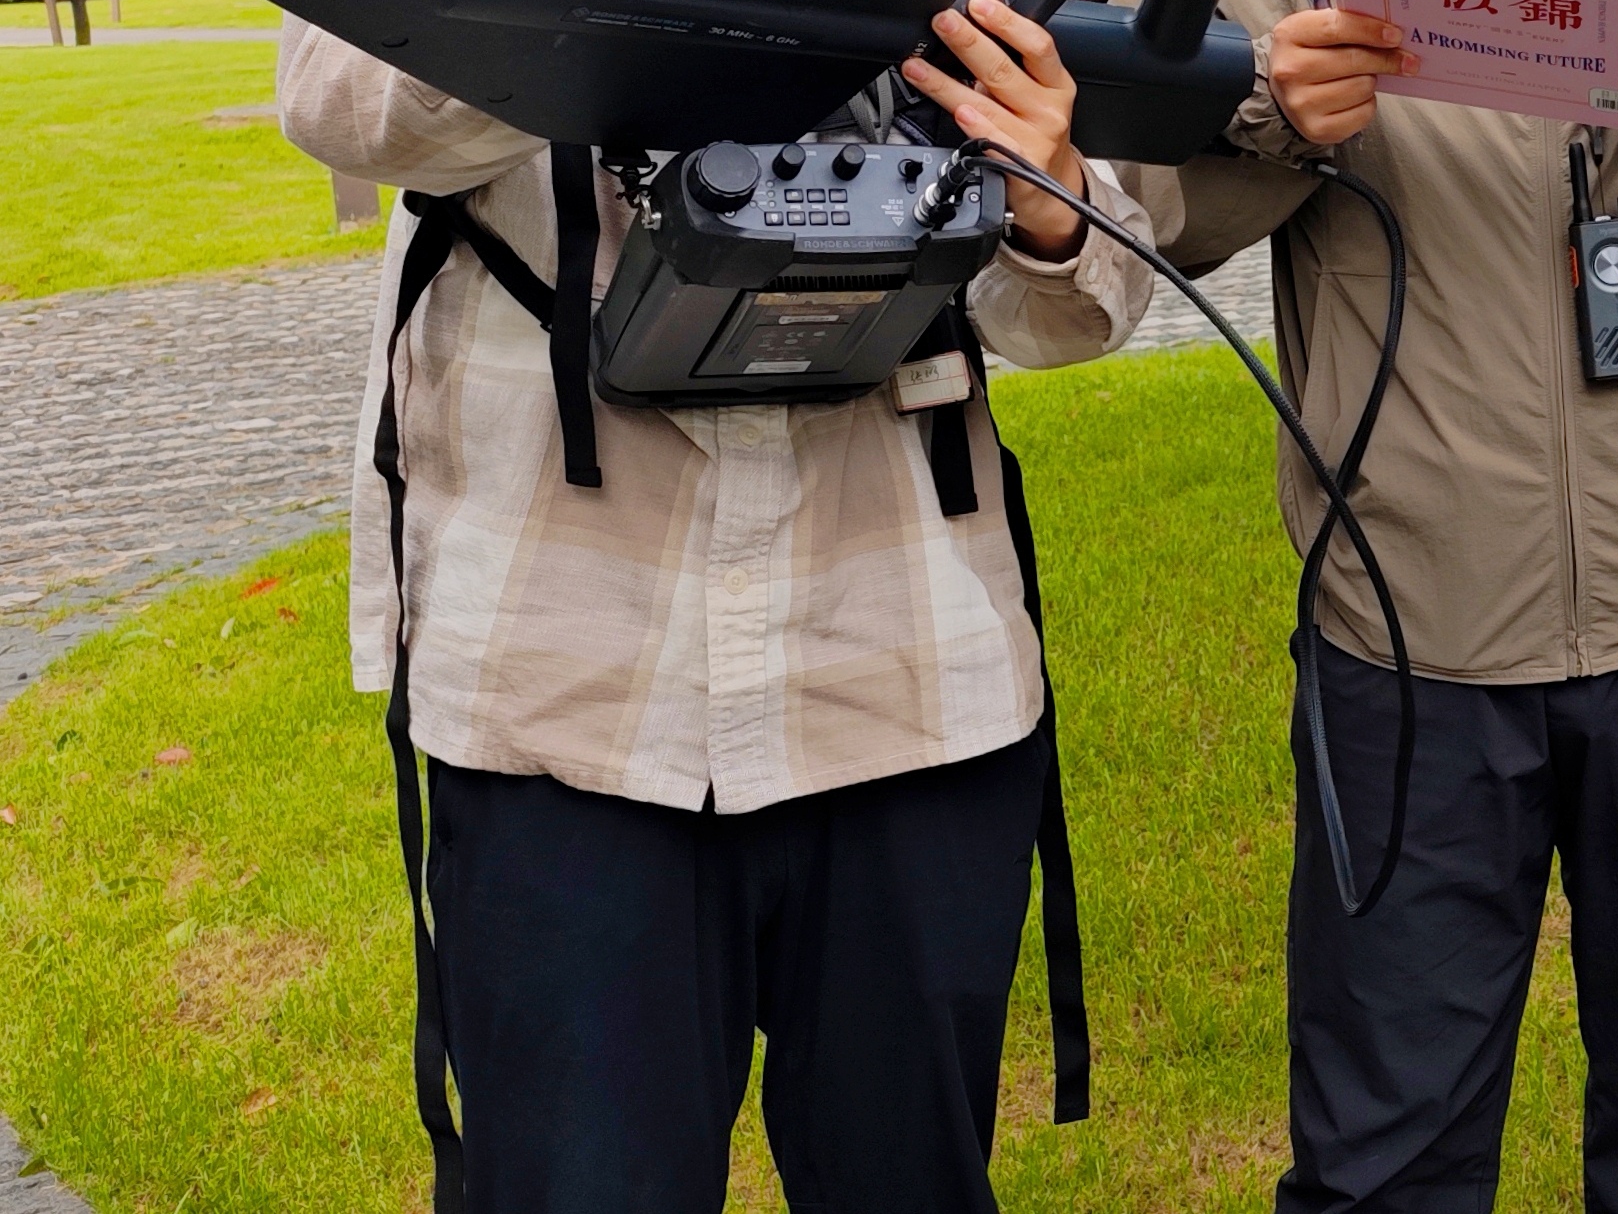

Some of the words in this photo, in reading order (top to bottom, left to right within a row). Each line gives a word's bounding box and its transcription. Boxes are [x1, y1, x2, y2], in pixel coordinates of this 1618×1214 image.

[708, 26, 726, 35] 30
[727, 28, 755, 40] MHz
[1410, 27, 1424, 44] A
[1428, 30, 1530, 62] PROMISING
[1535, 53, 1606, 74] FUTURE
[803, 239, 909, 250] ROHDE&SCHWA
